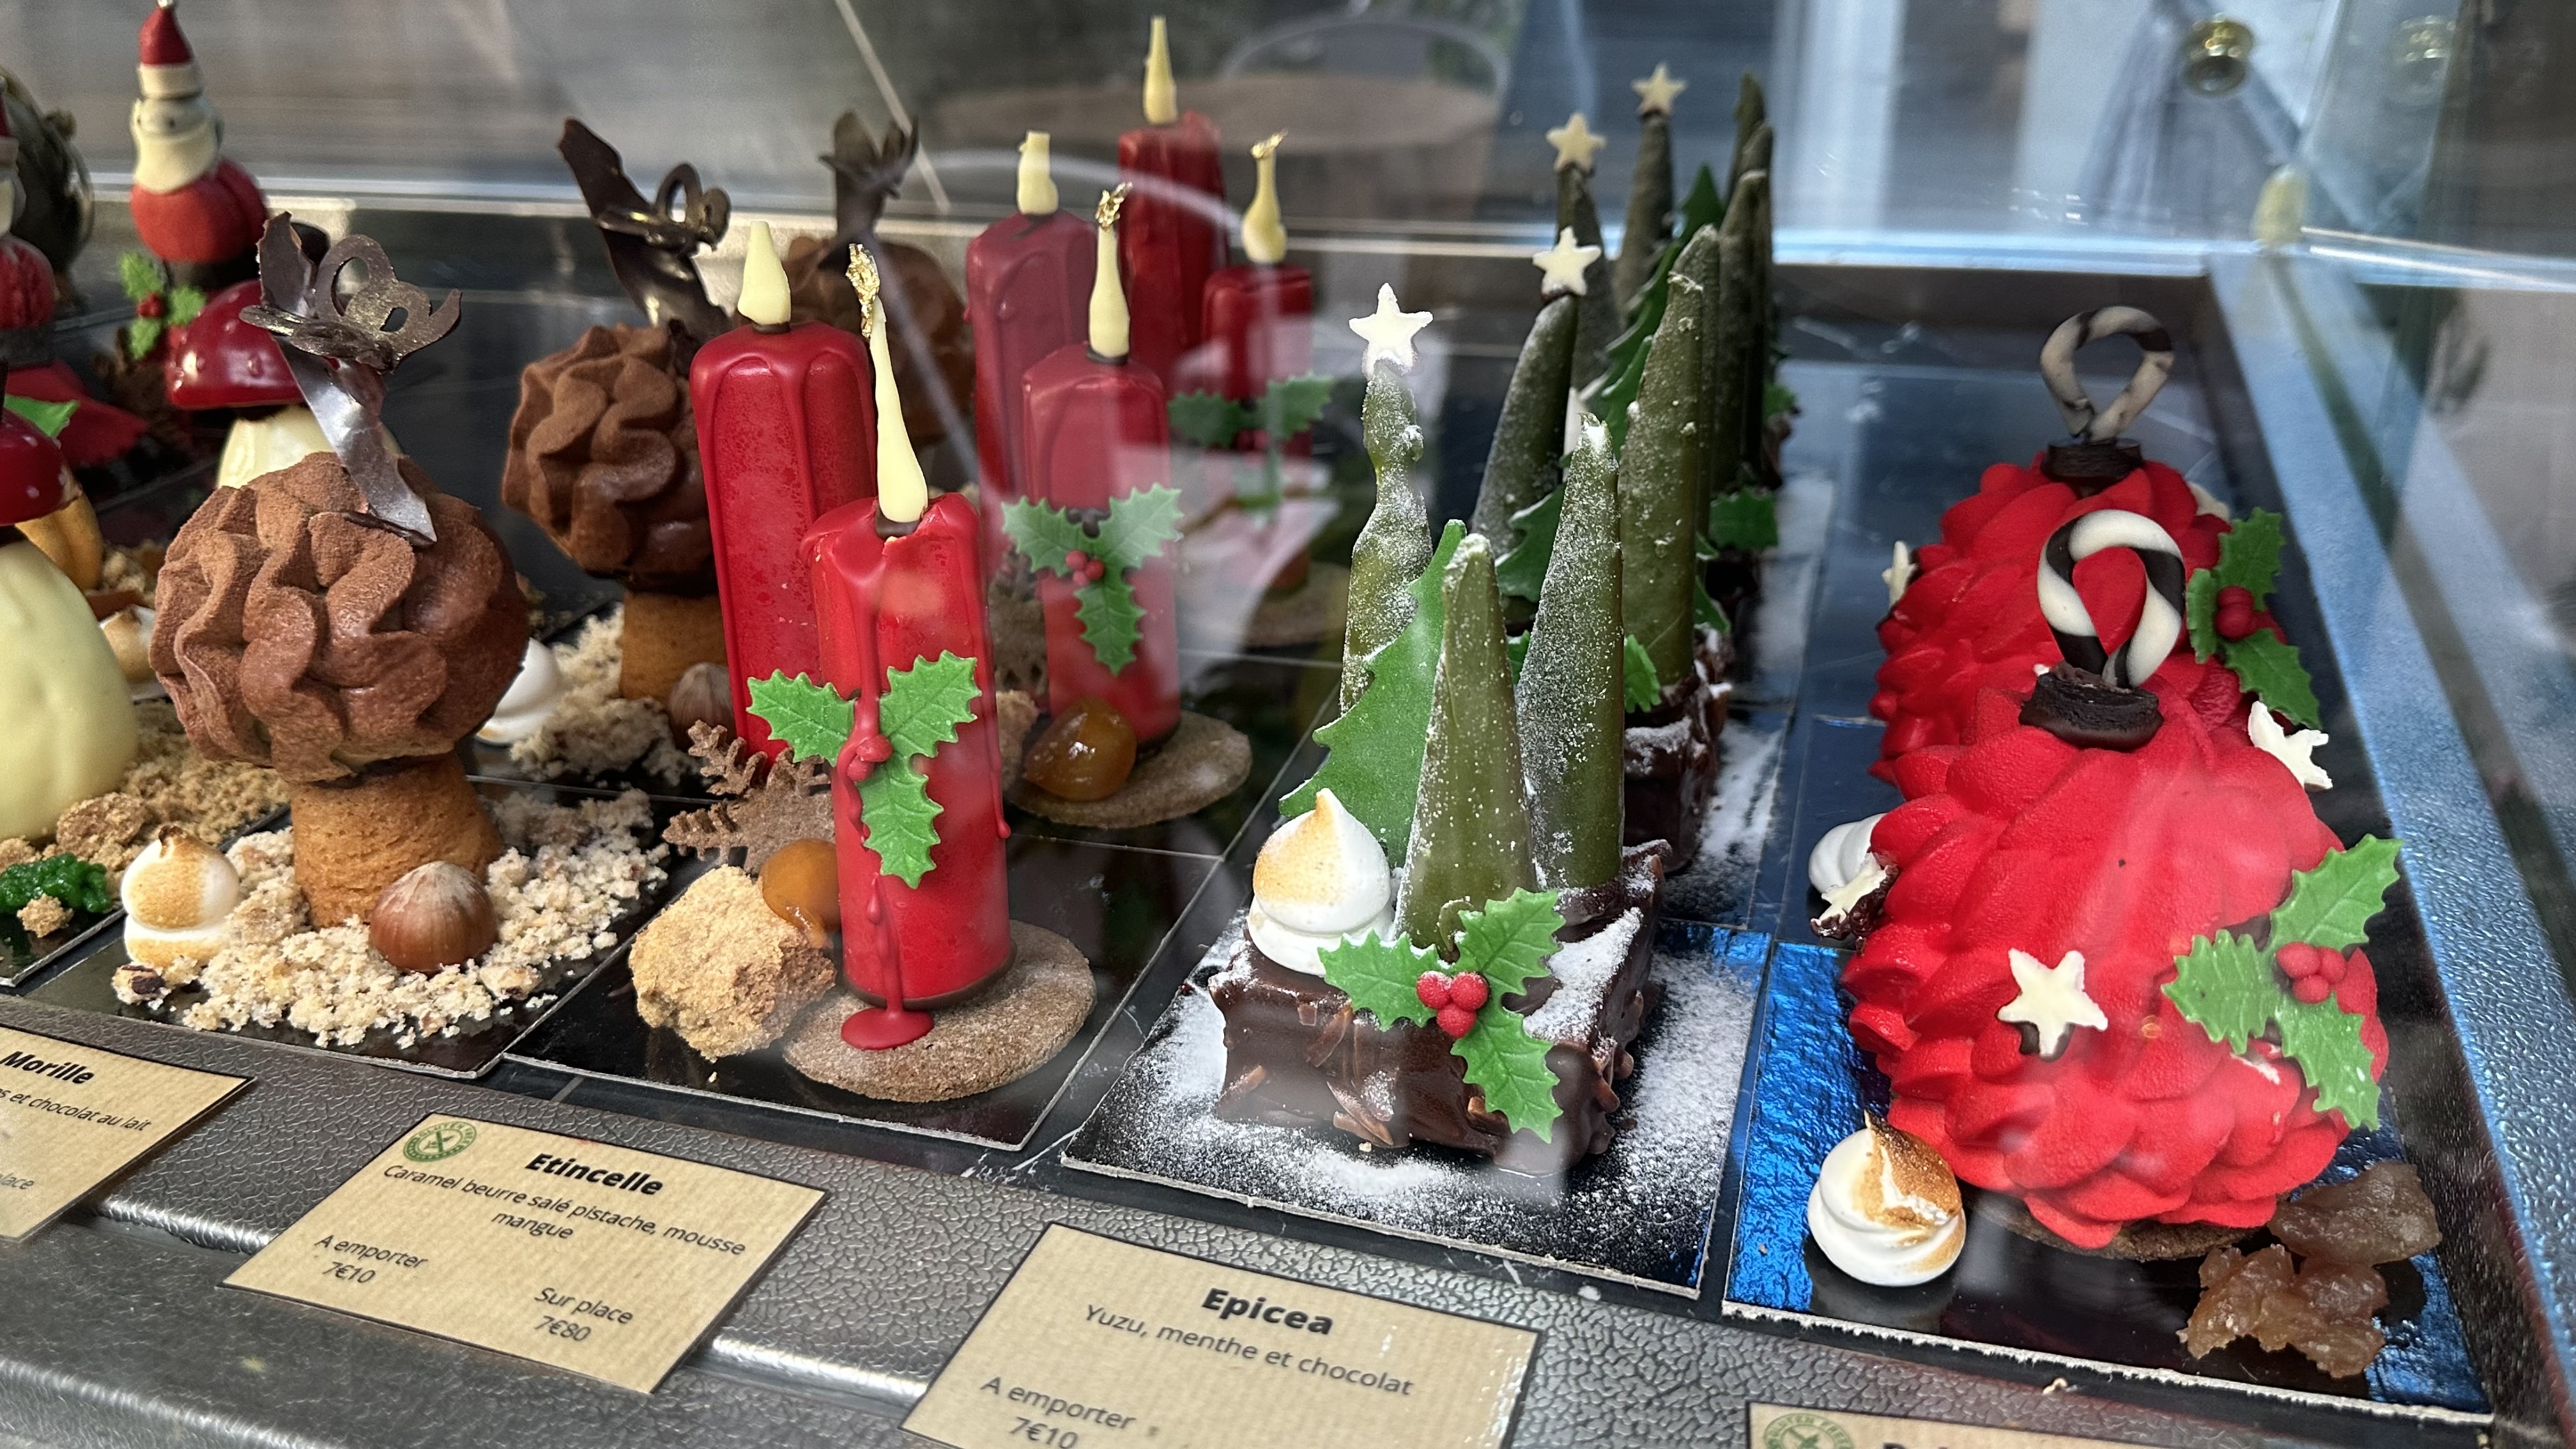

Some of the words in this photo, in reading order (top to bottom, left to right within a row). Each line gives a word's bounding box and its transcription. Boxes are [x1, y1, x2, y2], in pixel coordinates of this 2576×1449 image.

[0, 1051, 95, 1084] Morille
[9, 1093, 32, 1104] et
[28, 1098, 101, 1121] chocolat
[96, 1114, 123, 1126] au
[119, 1117, 152, 1131] lait
[0, 1173, 34, 1189] lace
[524, 1153, 664, 1195] Etincelle
[383, 1165, 464, 1189] Caramel
[461, 1179, 528, 1204] beurre
[526, 1197, 573, 1213] salé
[567, 1204, 657, 1235] pistache,
[663, 1225, 746, 1256] mousse
[491, 1213, 574, 1239] mangue
[313, 1234, 334, 1248] A
[334, 1240, 429, 1268] emporter
[322, 1261, 376, 1284] 7€10
[534, 1287, 576, 1307] Sur
[570, 1300, 634, 1324] place
[1201, 1287, 1334, 1335] Epicea
[534, 1315, 592, 1342] 7€80
[1086, 1304, 1148, 1338] Yuzu,
[1156, 1326, 1259, 1360] menthe
[1264, 1350, 1294, 1367] et
[1298, 1356, 1414, 1395] chocolat
[979, 1376, 1002, 1395] A
[1007, 1386, 1137, 1430] emporter
[1009, 1416, 1079, 1449] 7€10
